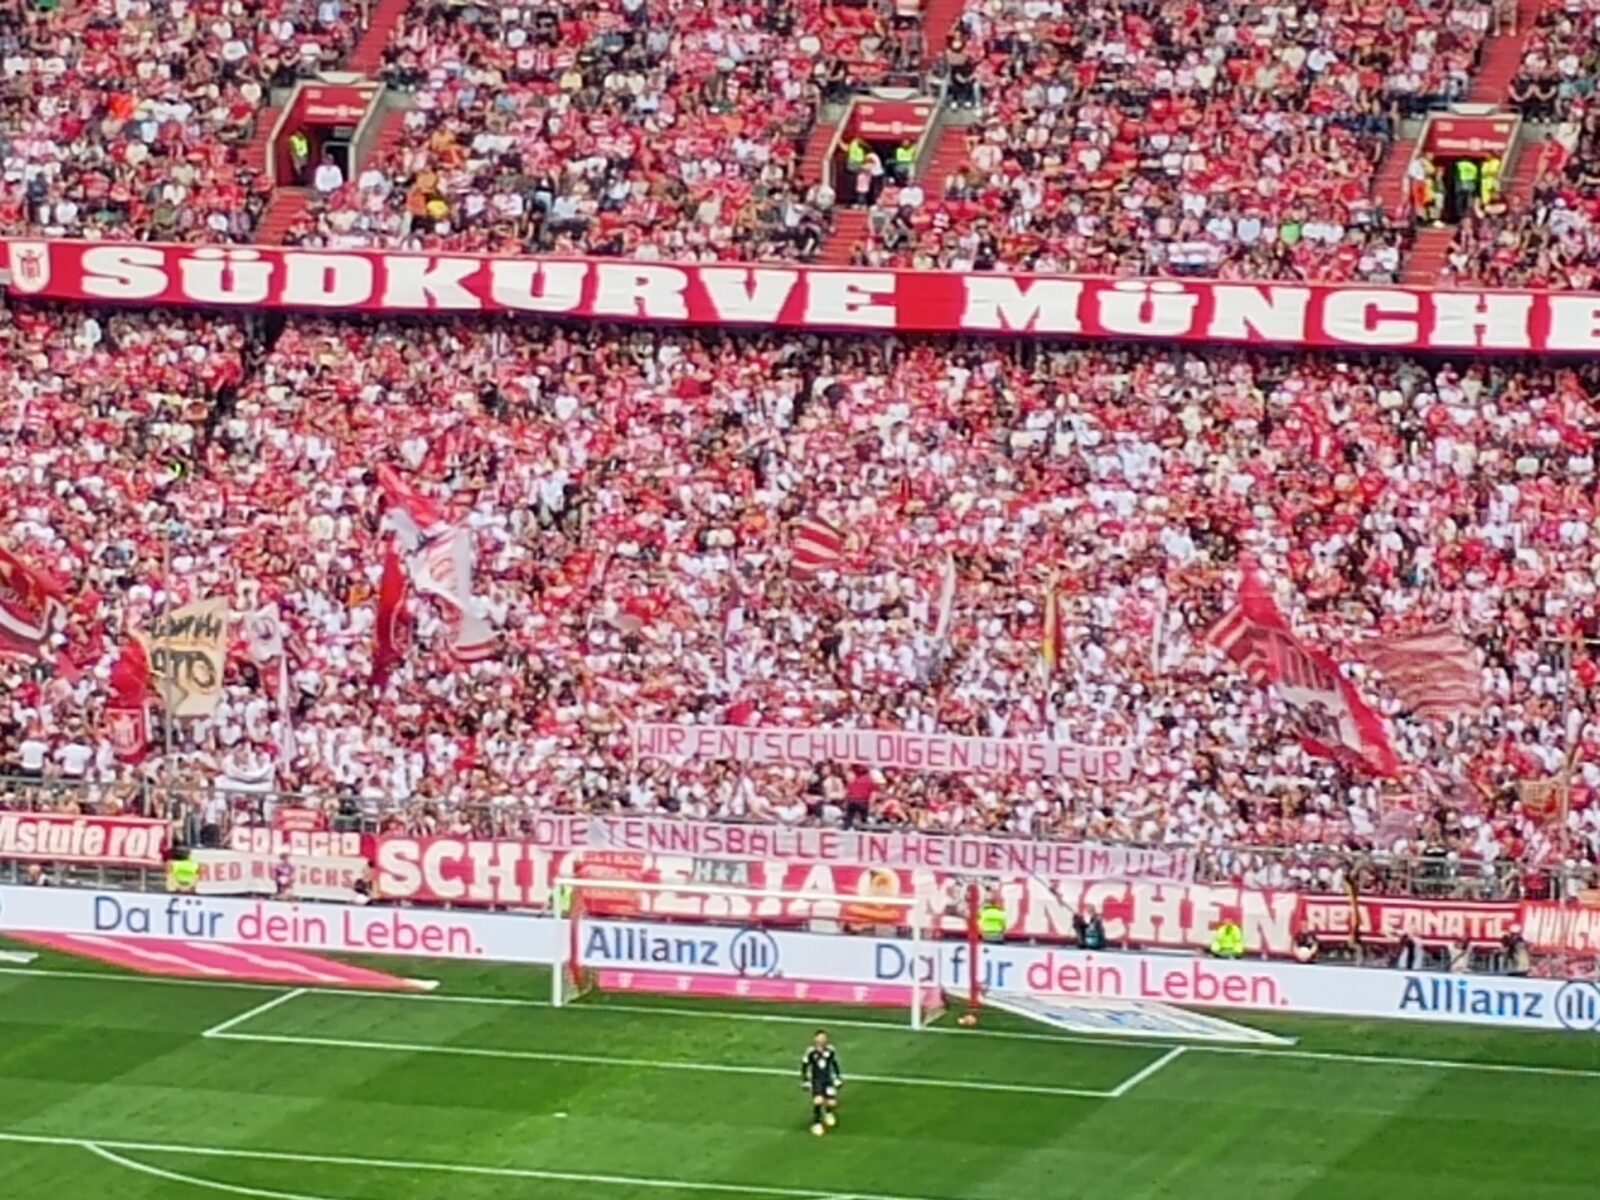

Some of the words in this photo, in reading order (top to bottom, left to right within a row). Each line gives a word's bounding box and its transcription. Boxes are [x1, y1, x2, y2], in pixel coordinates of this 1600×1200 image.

[81, 246, 897, 327] SÜDKURVE
[637, 727, 686, 757] WIR
[698, 729, 969, 768] ENTSCHULDIGEN
[981, 741, 1046, 770] UNS
[109, 824, 164, 859] rot
[536, 818, 588, 846] DIE
[858, 836, 887, 863] IN
[94, 896, 149, 933] Da
[166, 900, 223, 937] für
[238, 906, 325, 946] dein
[344, 912, 483, 954] Leben.
[584, 927, 718, 965] Allianz
[1027, 953, 1121, 994] dein
[1140, 961, 1288, 1005] Leben.
[1399, 976, 1542, 1018] Allianz
